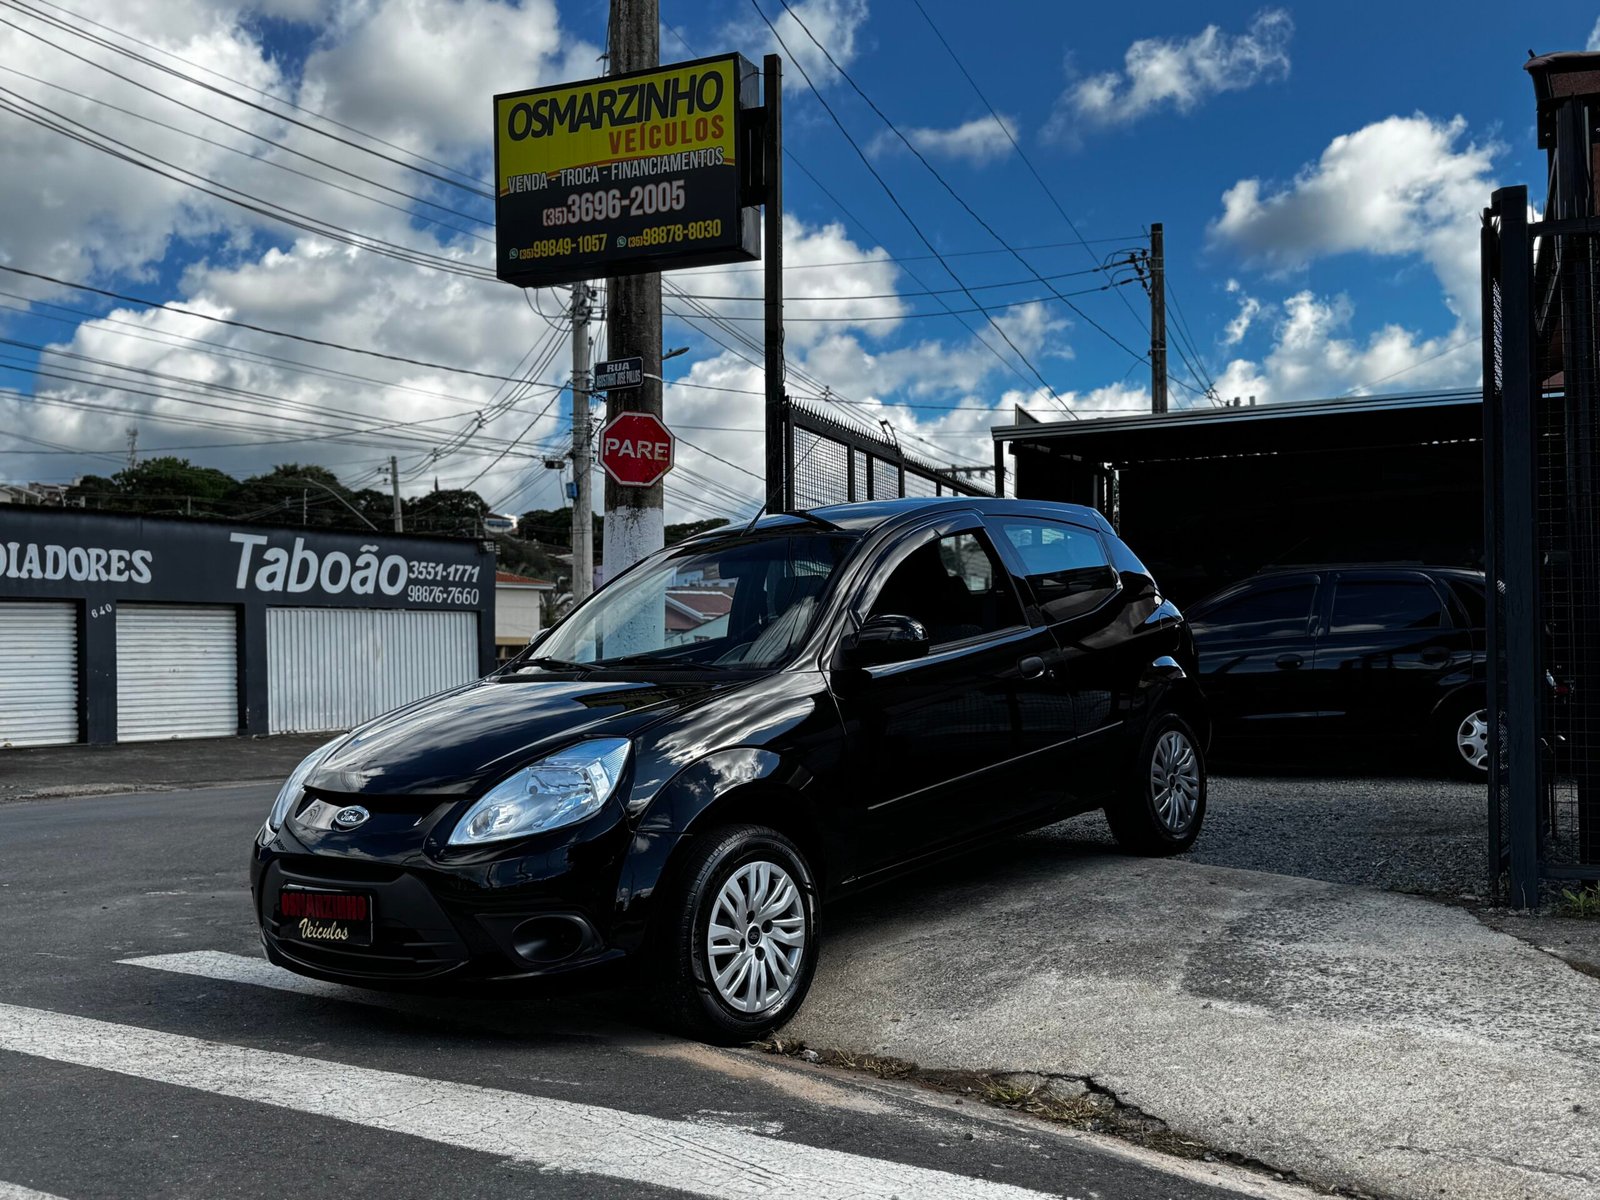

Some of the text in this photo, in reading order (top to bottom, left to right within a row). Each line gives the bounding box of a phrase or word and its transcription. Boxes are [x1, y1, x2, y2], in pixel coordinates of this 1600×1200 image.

[507, 70, 725, 141] OSMARZINHO
[609, 114, 725, 155] VEÍCULOS
[507, 172, 548, 194] VENDA
[560, 165, 600, 187] TROCA
[610, 146, 724, 181] FINANCIAMENTOS
[606, 362, 630, 373] RUA
[605, 437, 669, 461] PARE
[229, 532, 407, 596] Taboão
[340, 810, 359, 822] Ford
